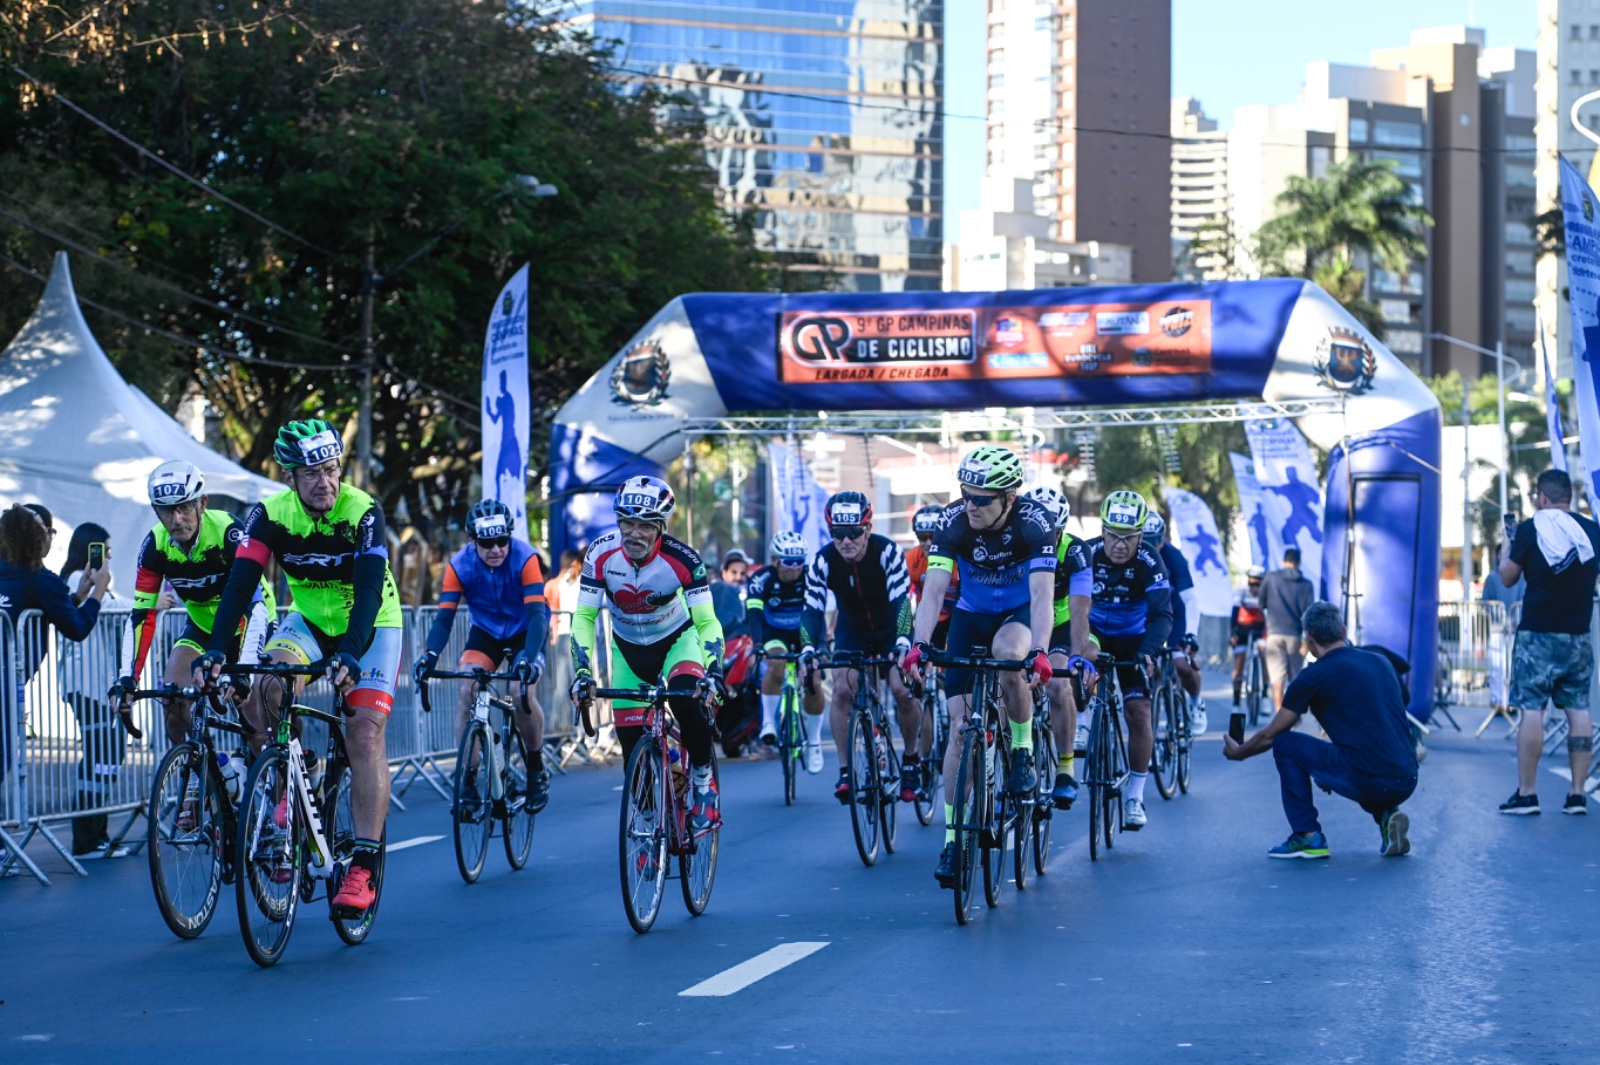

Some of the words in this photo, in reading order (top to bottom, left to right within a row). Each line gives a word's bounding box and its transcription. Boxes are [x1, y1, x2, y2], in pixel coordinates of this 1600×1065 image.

[876, 317, 895, 333] GP
[898, 315, 971, 332] CAMPINAS
[857, 339, 879, 358] DE
[888, 337, 971, 358] CICLISMO
[815, 368, 875, 381] LARGADA
[889, 366, 949, 379] CHEGADA
[313, 443, 336, 461] 103
[960, 470, 979, 484] 101
[156, 484, 180, 496] 107
[627, 494, 651, 507] 108
[835, 514, 856, 523] 105
[1115, 514, 1129, 523] 99
[482, 524, 502, 537] 100
[188, 859, 220, 930] EASTON
